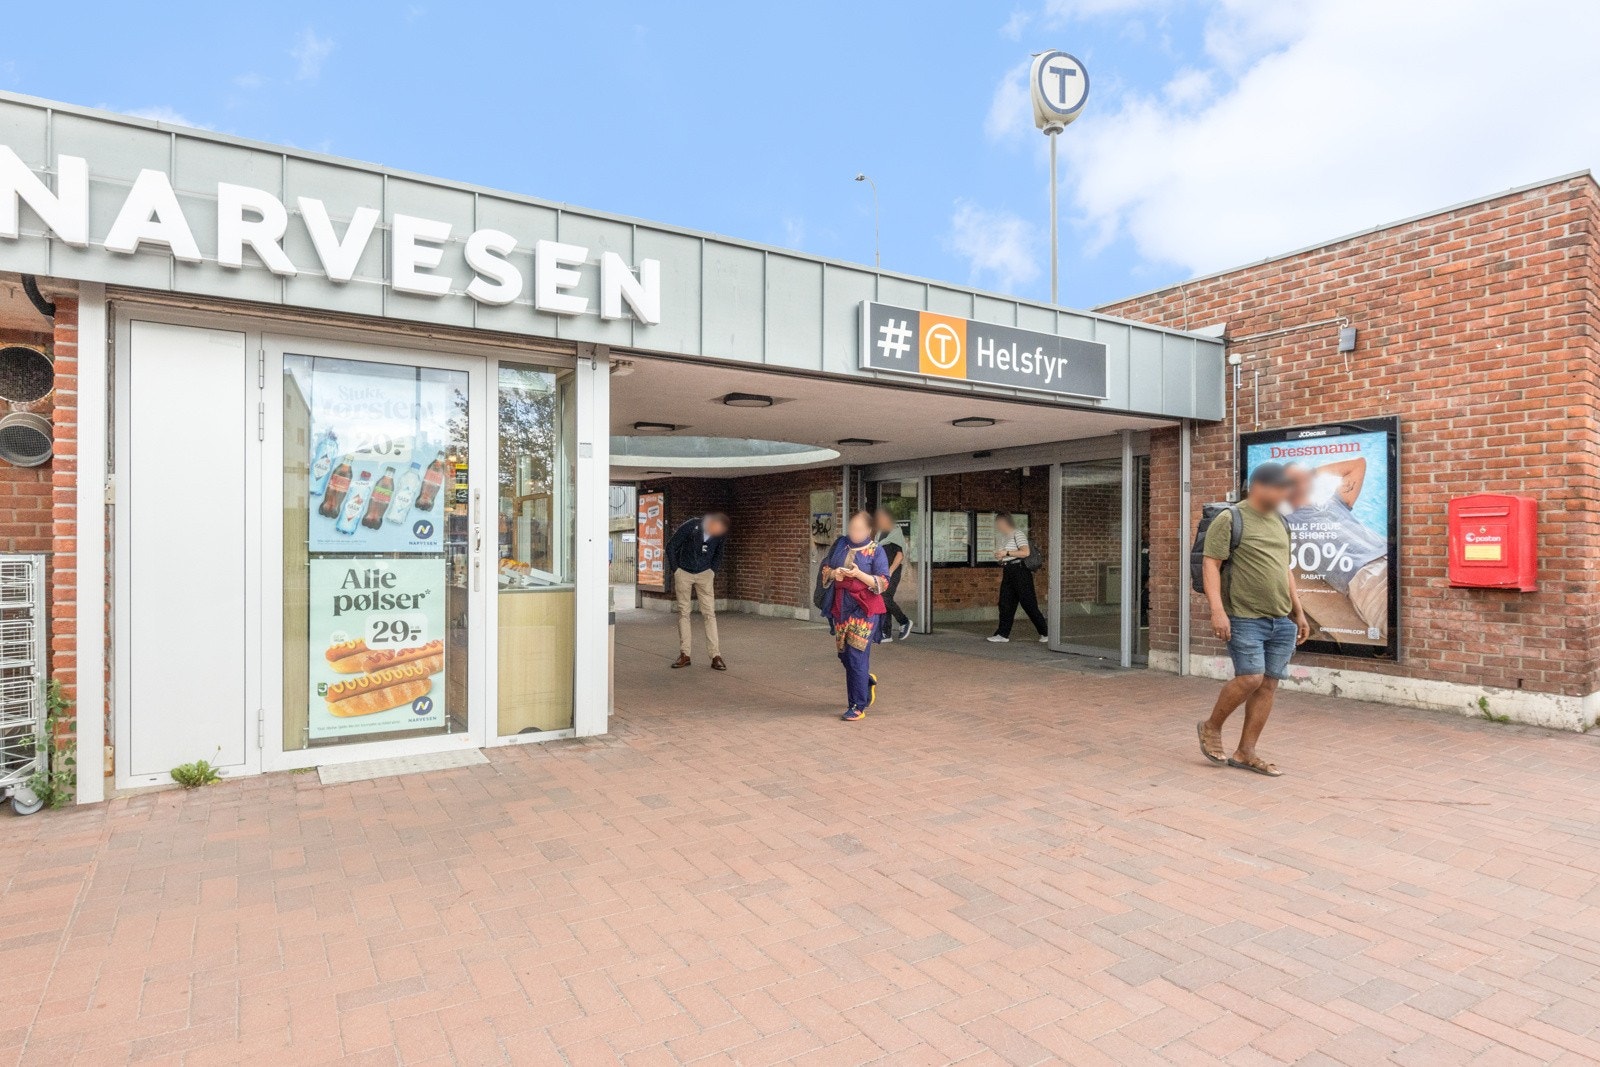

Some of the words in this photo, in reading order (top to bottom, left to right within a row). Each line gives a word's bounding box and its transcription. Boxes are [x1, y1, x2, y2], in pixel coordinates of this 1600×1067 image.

[0, 144, 661, 326] NARVESEN
[977, 336, 1068, 384] Helsfyr
[1298, 430, 1327, 439] JCDecaux
[1270, 442, 1360, 458] Dressmann
[1298, 531, 1338, 540] SHORTS
[1475, 535, 1501, 543] posten
[340, 568, 397, 590] Alle
[1319, 627, 1366, 635] DRESSMANN.COM
